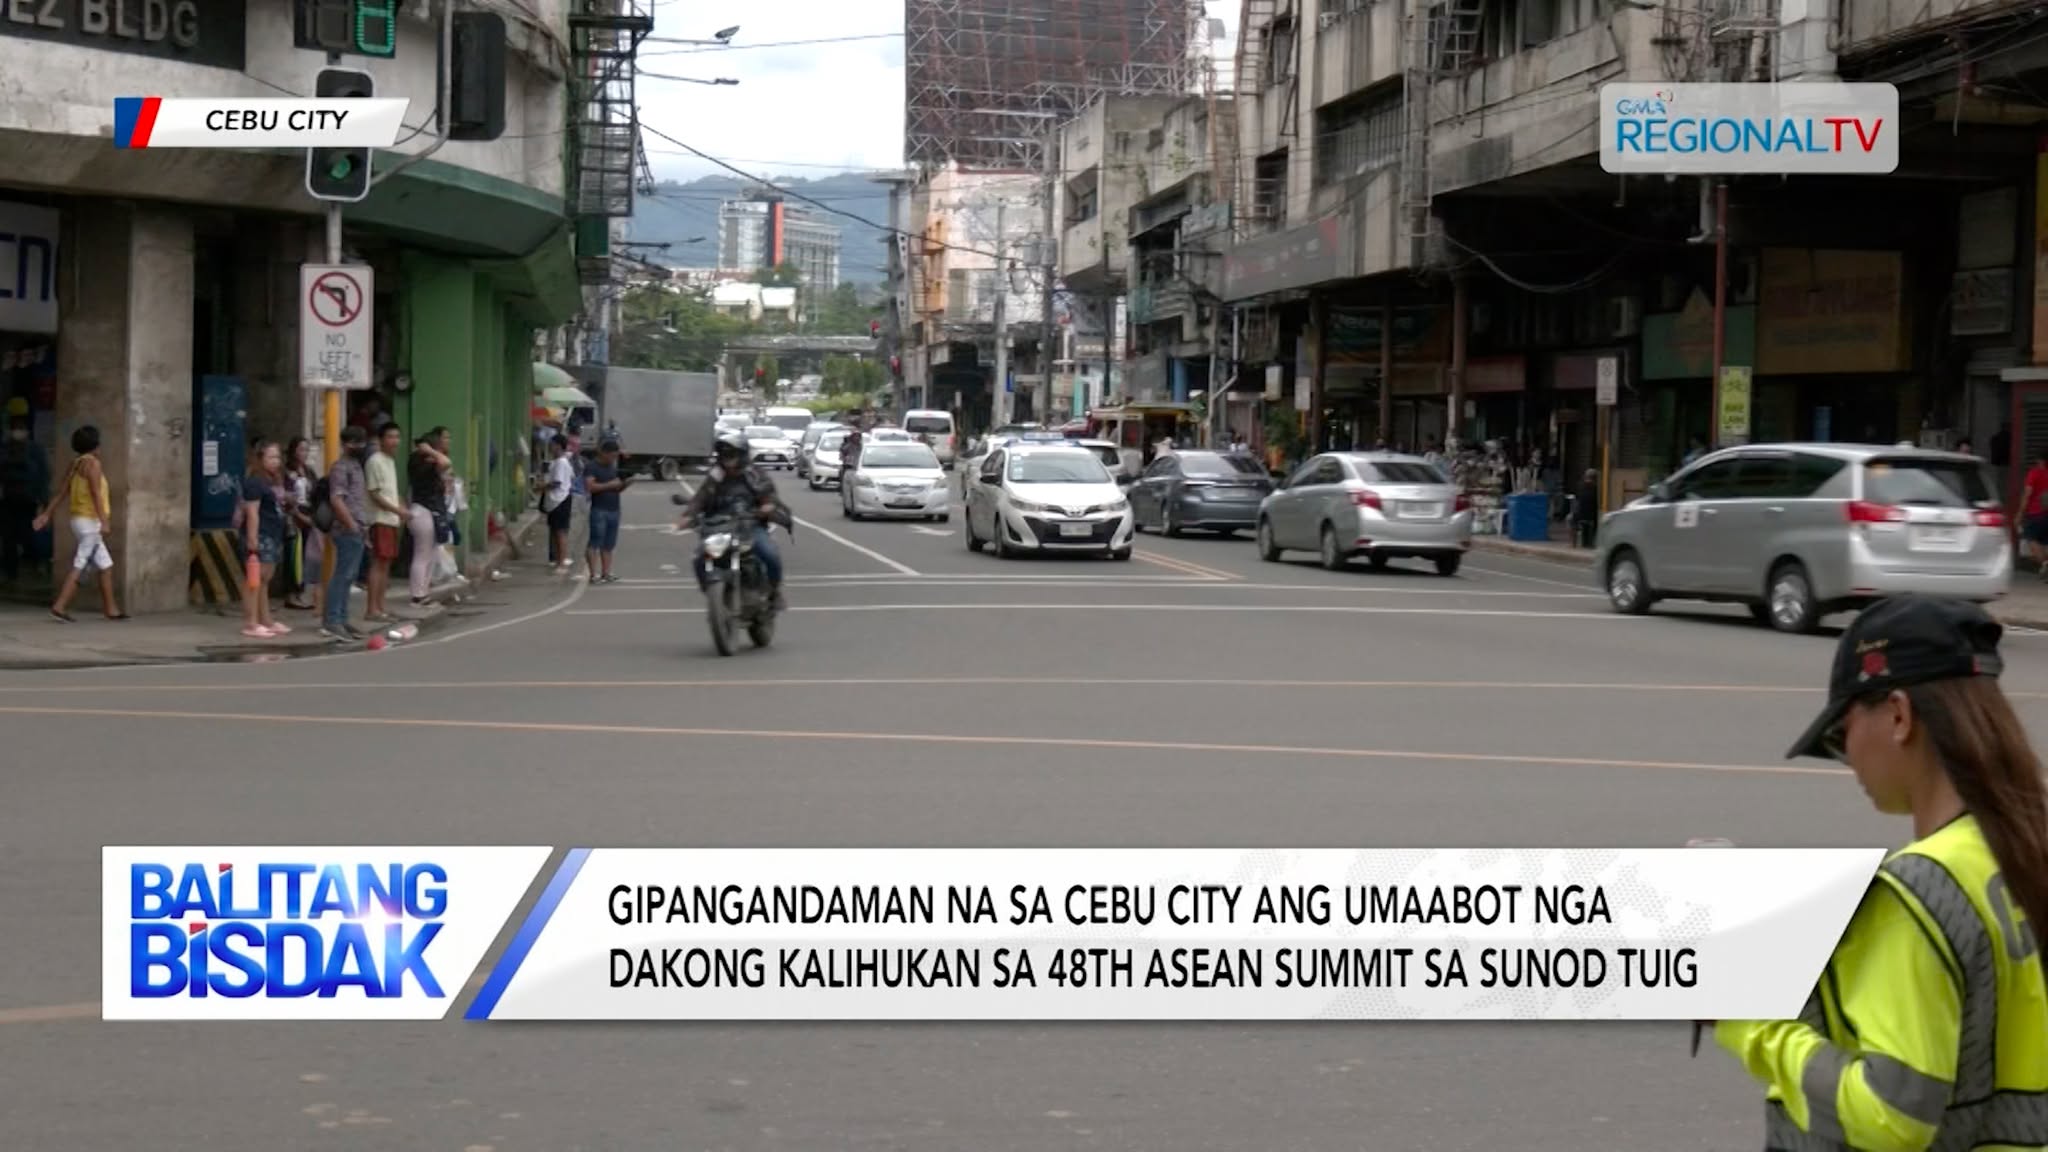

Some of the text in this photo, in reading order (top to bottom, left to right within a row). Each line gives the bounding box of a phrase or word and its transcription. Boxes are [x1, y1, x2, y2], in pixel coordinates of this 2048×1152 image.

[0, 0, 199, 47] EZ BLDG
[325, 333, 346, 347] NO
[319, 351, 352, 367] LEFT
